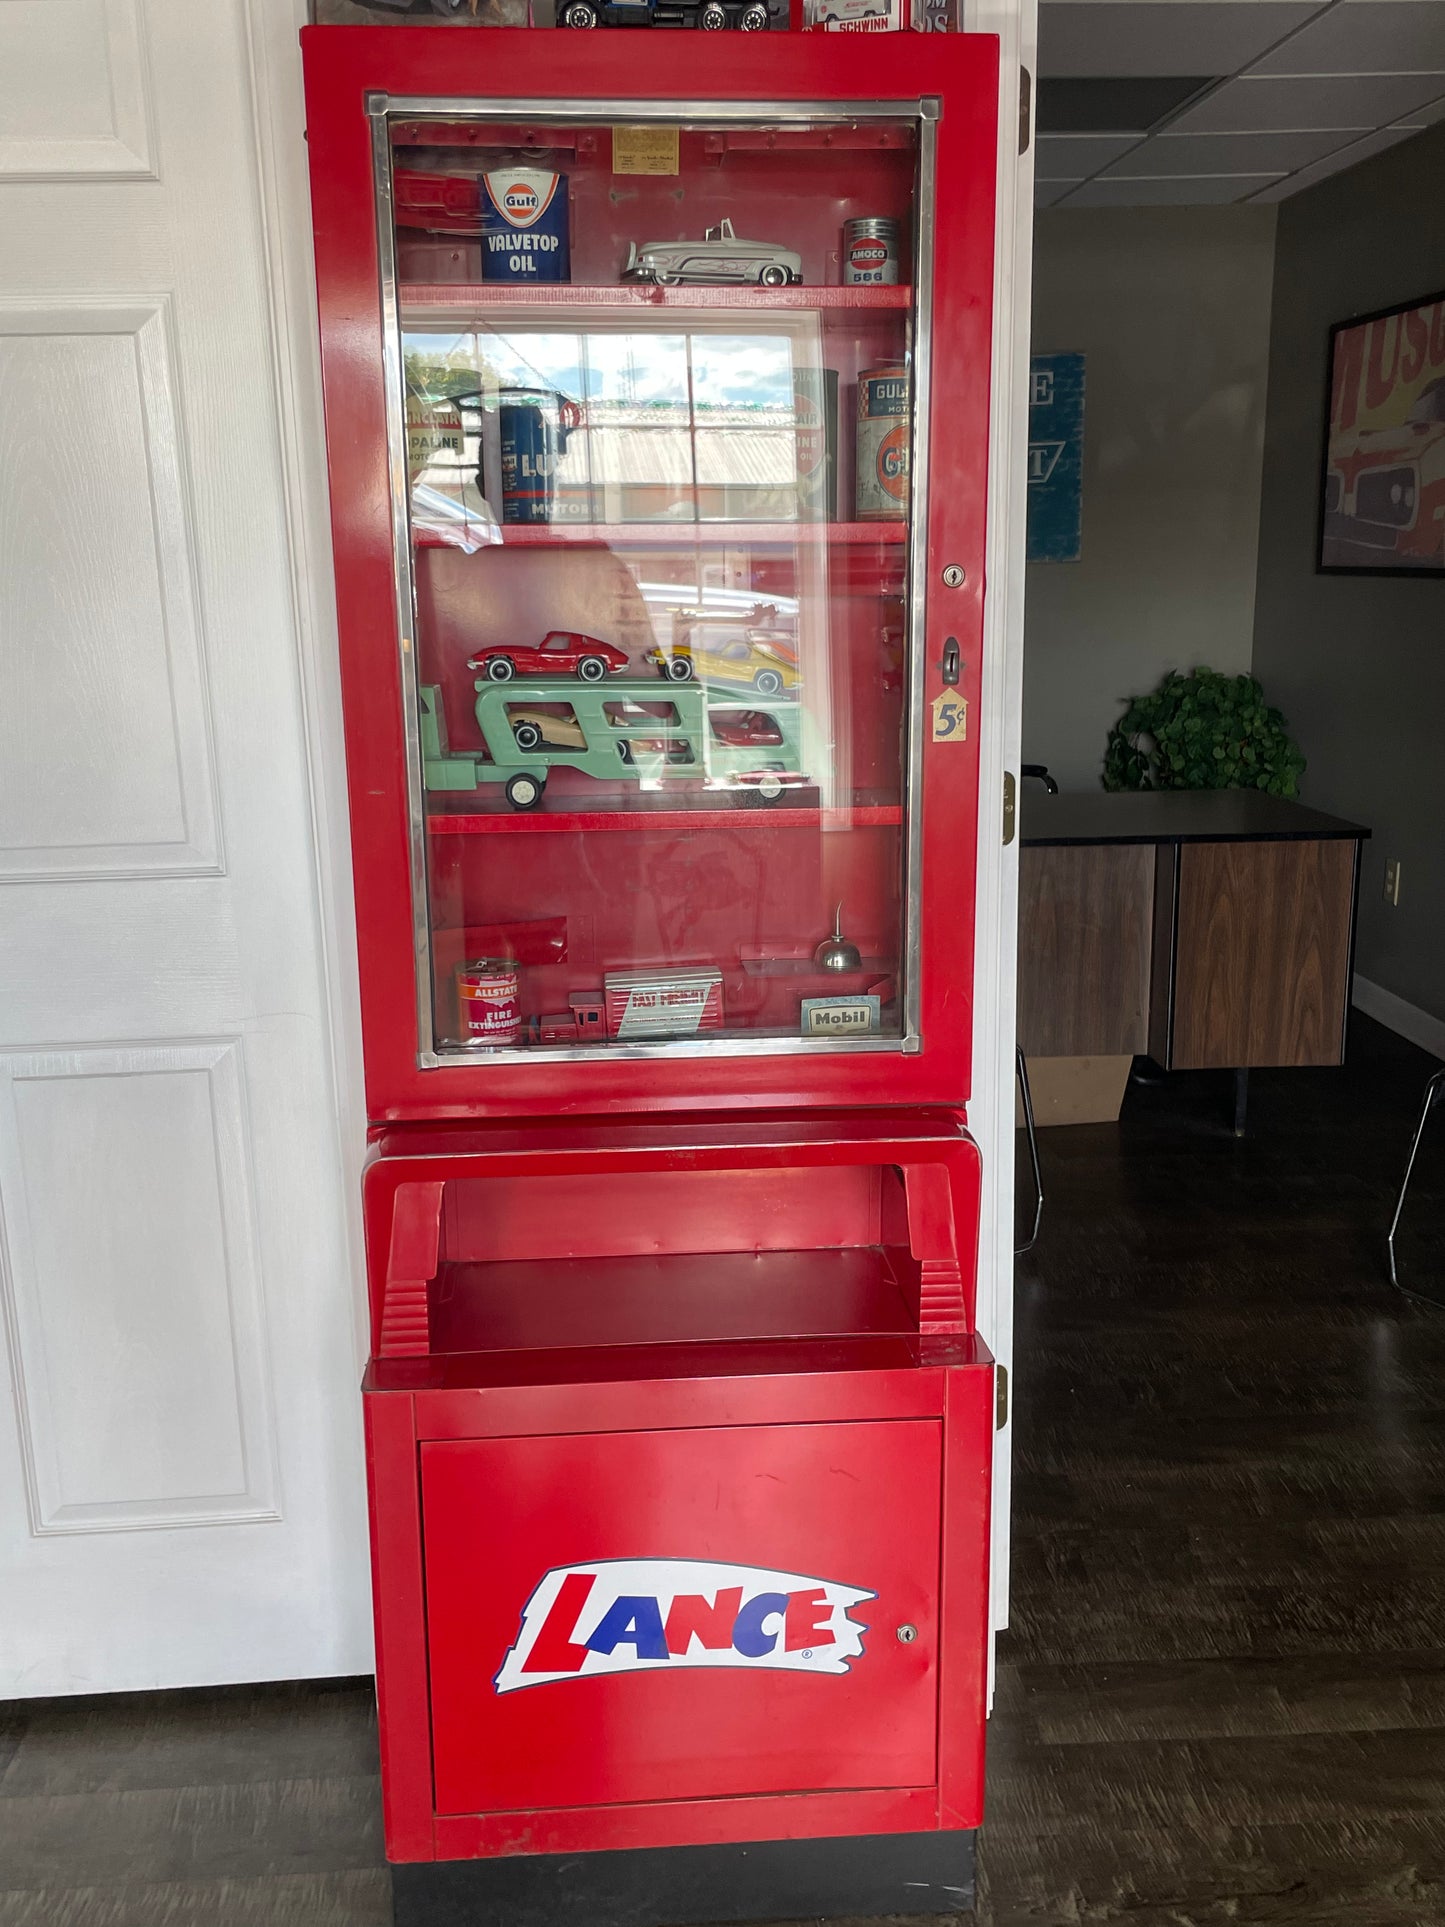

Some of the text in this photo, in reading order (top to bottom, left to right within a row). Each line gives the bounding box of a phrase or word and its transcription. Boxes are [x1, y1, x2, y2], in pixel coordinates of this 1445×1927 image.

[839, 17, 889, 33] SCHWINN
[506, 196, 537, 207] Gulf
[488, 234, 559, 252] VALVETOP
[851, 250, 885, 260] AMOCO
[509, 255, 537, 272] OIL
[853, 272, 883, 282] 586
[486, 1009, 512, 1020] FIRE
[815, 1011, 866, 1025] Mobil
[520, 1573, 837, 1673] LANCE
